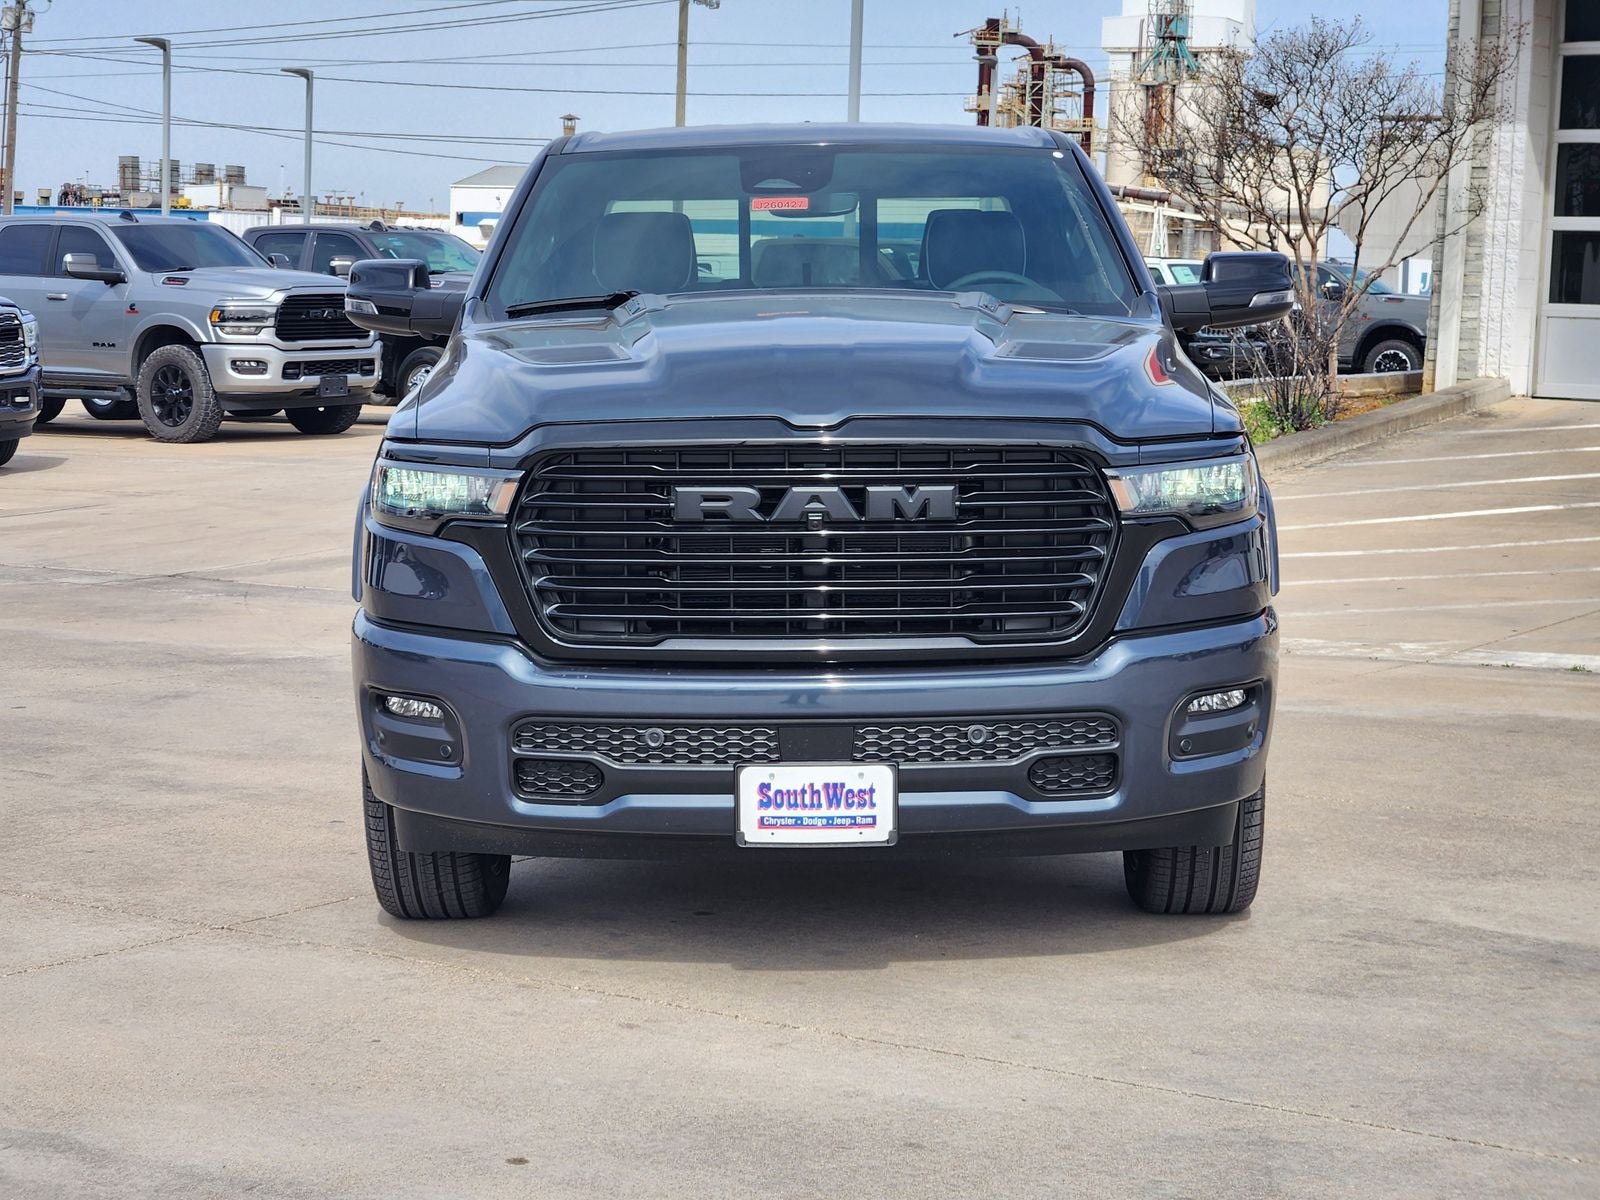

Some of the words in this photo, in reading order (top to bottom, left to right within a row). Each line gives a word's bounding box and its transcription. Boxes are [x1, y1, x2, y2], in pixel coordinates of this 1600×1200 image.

[673, 484, 959, 521] RAM
[757, 782, 877, 811] SouthWest
[763, 816, 796, 826] Chrysler
[802, 816, 827, 826] Dodge
[832, 816, 851, 827] Jeep
[855, 816, 873, 825] Ram
